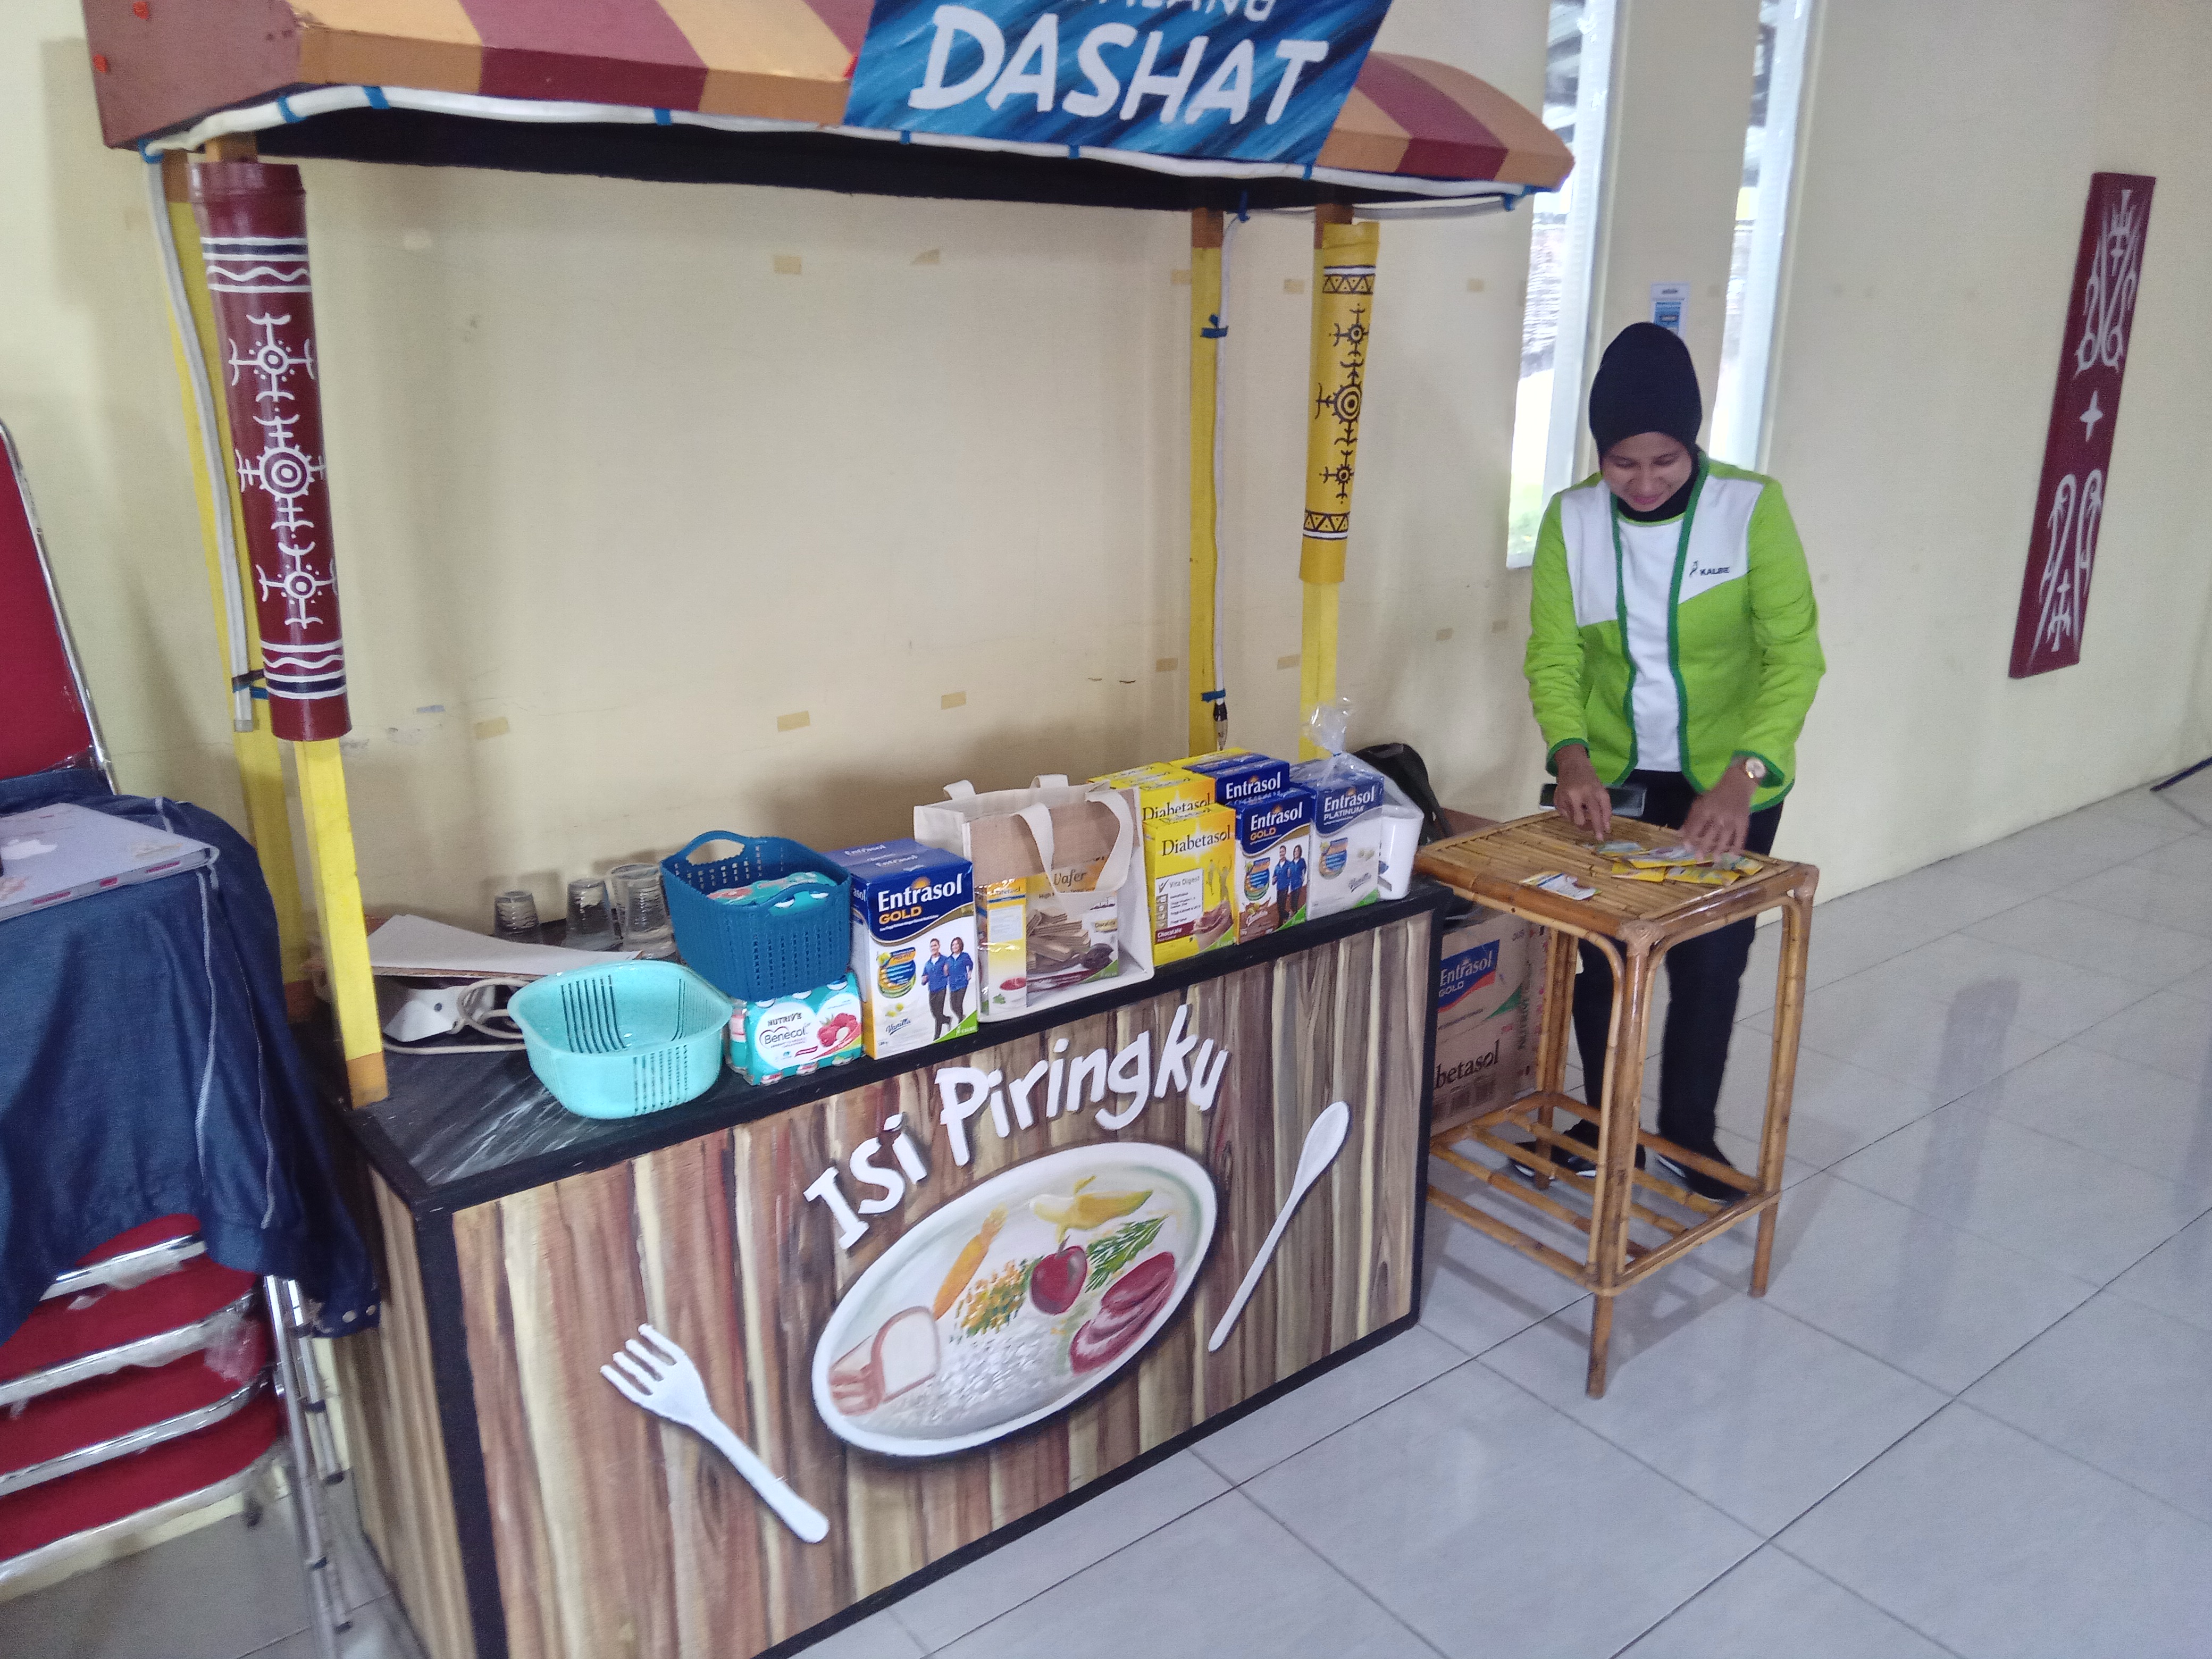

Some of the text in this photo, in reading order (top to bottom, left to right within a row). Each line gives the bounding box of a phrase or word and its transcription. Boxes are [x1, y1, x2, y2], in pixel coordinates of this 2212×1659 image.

[908, 5, 1328, 125] DASHAT
[1226, 772, 1281, 800] Entrasol
[1324, 786, 1375, 814] Entrasol
[1251, 801, 1303, 831] Entrasol
[1324, 805, 1363, 820] PLATINUM
[1162, 825, 1230, 856] Diabetasol
[1250, 827, 1276, 841] GOLD
[878, 873, 963, 912] Entrasol
[879, 906, 922, 925] GOLD
[1440, 950, 1492, 987] Entrasol
[1439, 980, 1464, 998] GOLD
[764, 1027, 806, 1045] Benecol
[885, 1018, 911, 1036] Vanilla
[935, 1004, 1228, 1167] Piringku
